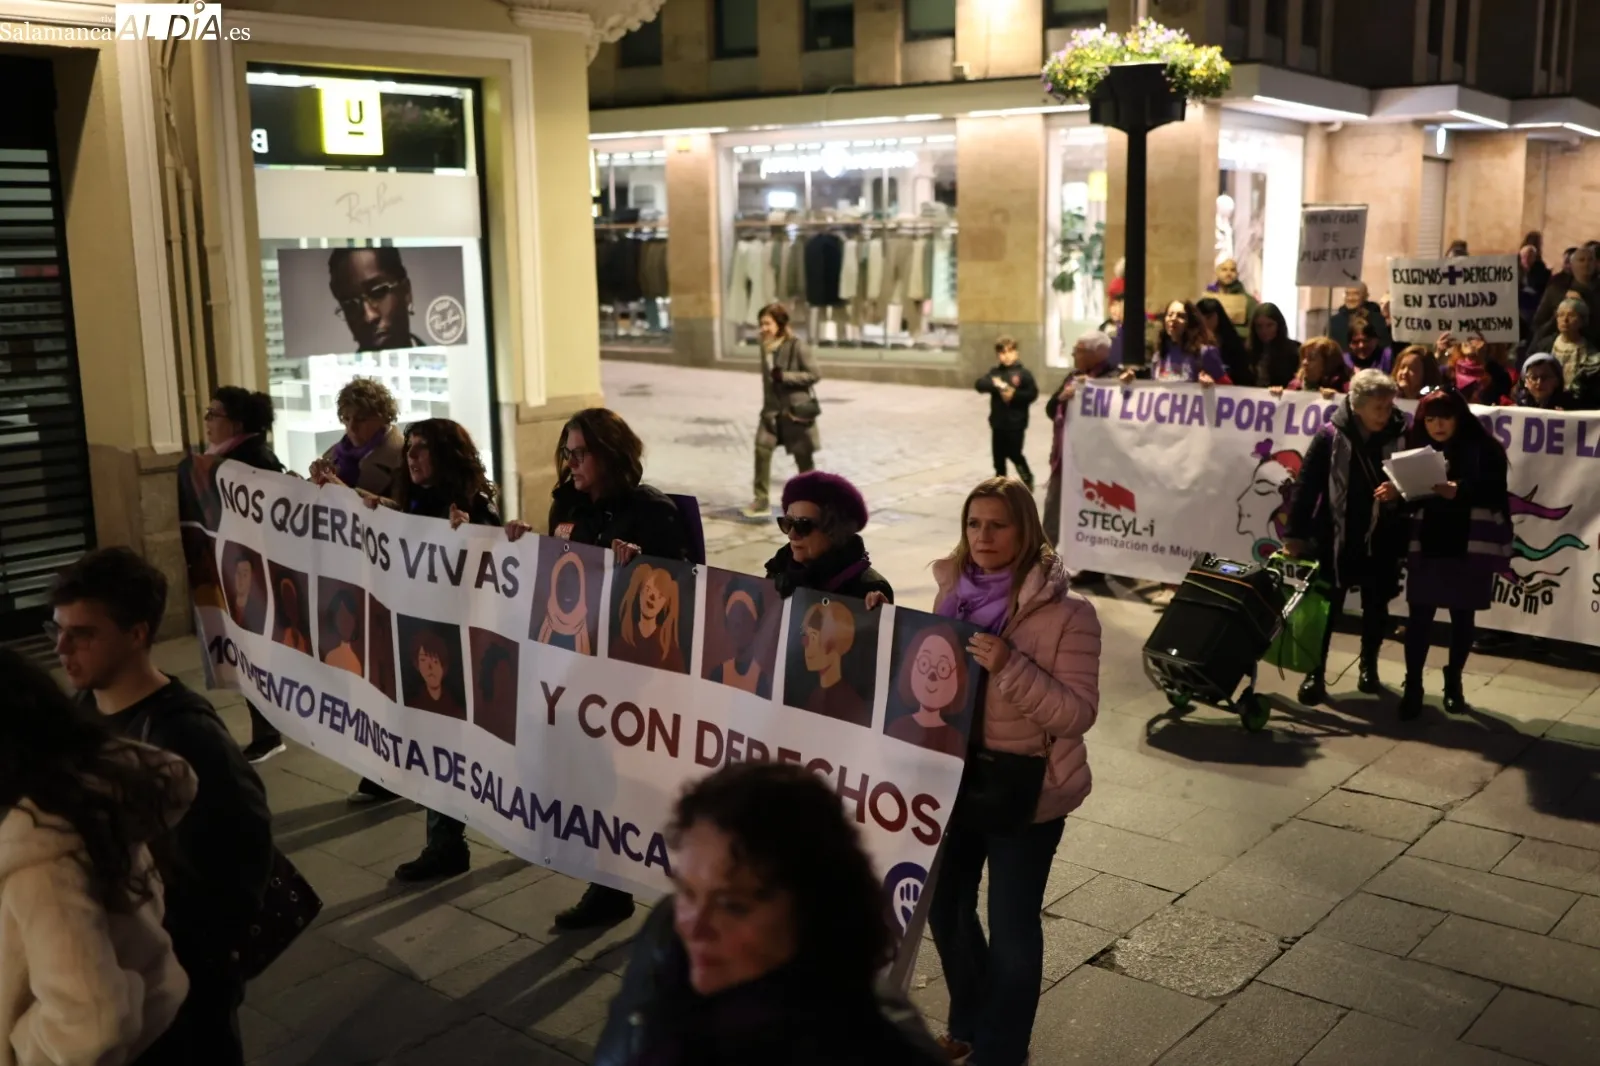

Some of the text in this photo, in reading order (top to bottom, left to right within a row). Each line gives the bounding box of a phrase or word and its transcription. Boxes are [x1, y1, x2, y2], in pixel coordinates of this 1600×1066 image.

[1299, 246, 1360, 263] MUERTE
[1392, 267, 1443, 285] EXIGIMOS
[1463, 266, 1514, 283] DERECHOS
[1403, 291, 1498, 309] EN IGUALDAD
[1394, 316, 1514, 332] Y CERO EN MACHISMO
[1080, 387, 1114, 418] EN
[1119, 390, 1205, 427] LUCHA
[1215, 396, 1276, 433] POR
[1522, 417, 1565, 456] DE
[1576, 420, 1600, 458] L
[220, 477, 520, 599] NOS QUEREOS VIVAS
[1151, 543, 1166, 554] de
[1169, 544, 1218, 561] Muje
[540, 680, 566, 726] Y
[577, 693, 681, 759] CON
[318, 692, 429, 777] FEMINISTA
[433, 745, 466, 792] DE
[470, 761, 674, 878] SALAMANCA
